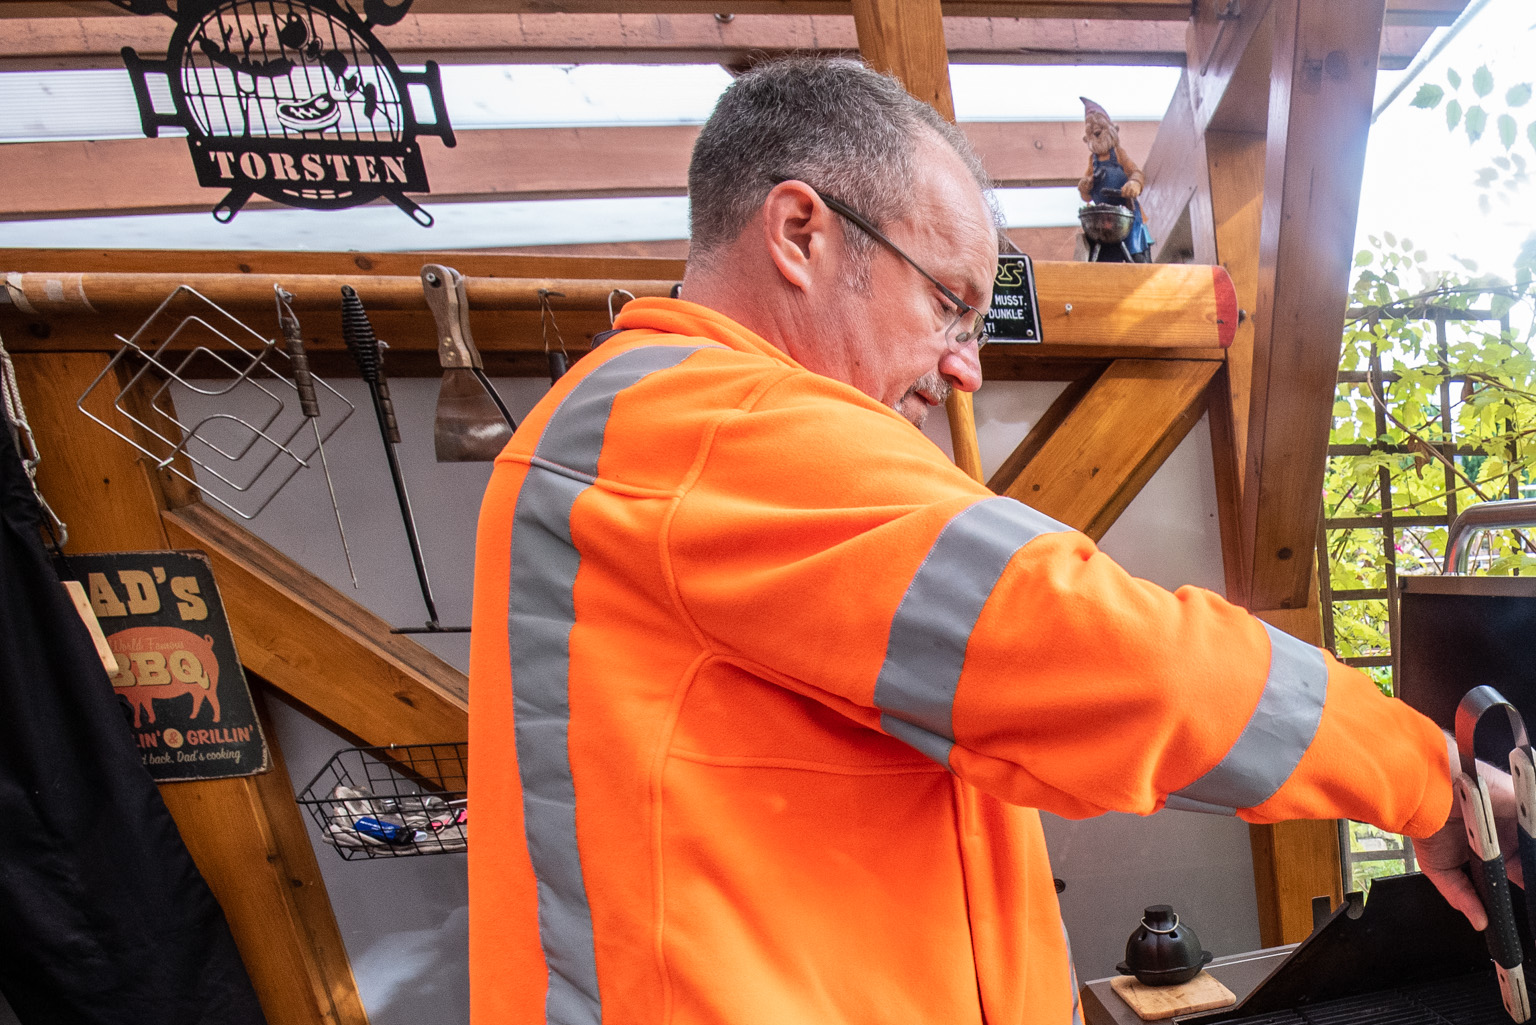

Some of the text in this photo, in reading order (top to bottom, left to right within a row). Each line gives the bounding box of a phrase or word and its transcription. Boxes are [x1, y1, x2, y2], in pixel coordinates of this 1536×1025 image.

[209, 151, 408, 183] TORSTEN
[995, 294, 1027, 306] MUSST.
[988, 308, 1024, 319] DUNKLE
[88, 566, 209, 621] AD'S
[110, 650, 210, 690] BBQ
[186, 724, 254, 745] GRILLIN'
[176, 749, 206, 763] Dad's
[206, 748, 241, 764] cooking
